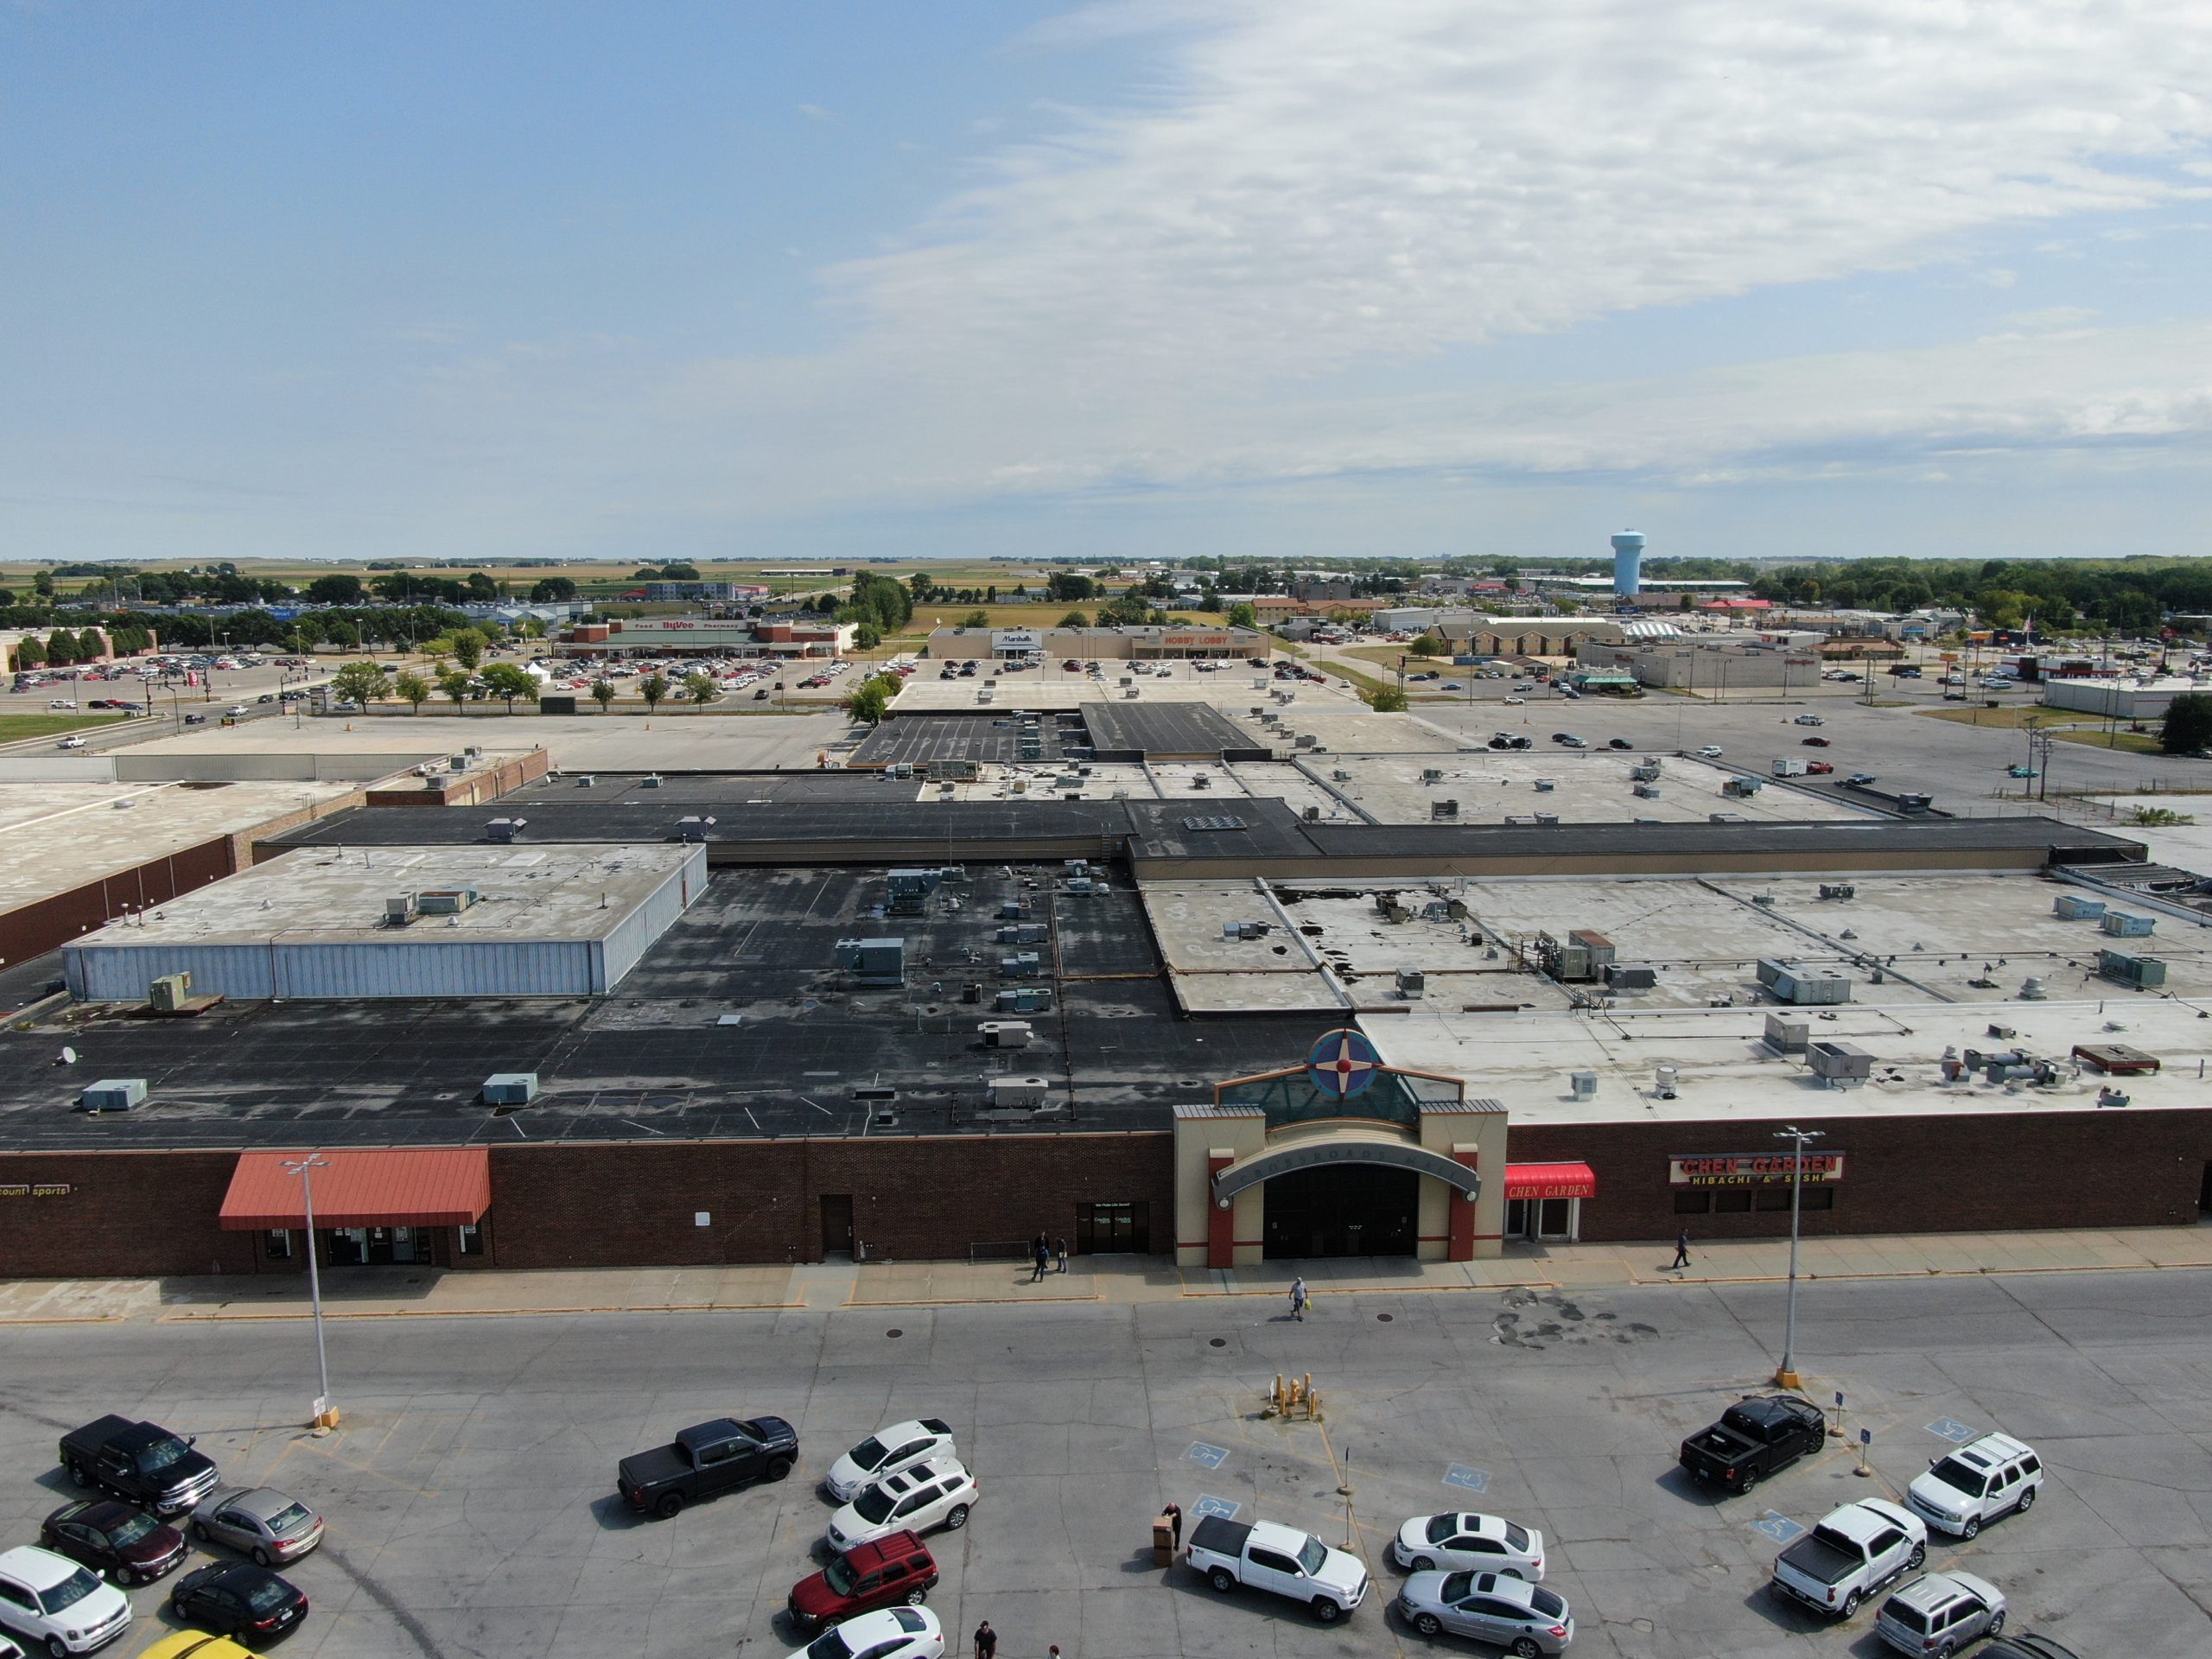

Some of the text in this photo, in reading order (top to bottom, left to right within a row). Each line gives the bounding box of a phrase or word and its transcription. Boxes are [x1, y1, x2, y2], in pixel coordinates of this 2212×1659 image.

[1165, 636, 1227, 645] HOBBY LOBBY
[1684, 1156, 1837, 1175] CHEN GARDEN
[1693, 1176, 1750, 1185] HIBACHI
[1784, 1173, 1826, 1183] SSHI
[33, 1187, 67, 1198] sports
[1509, 1185, 1590, 1198] CHEN GARDEN
